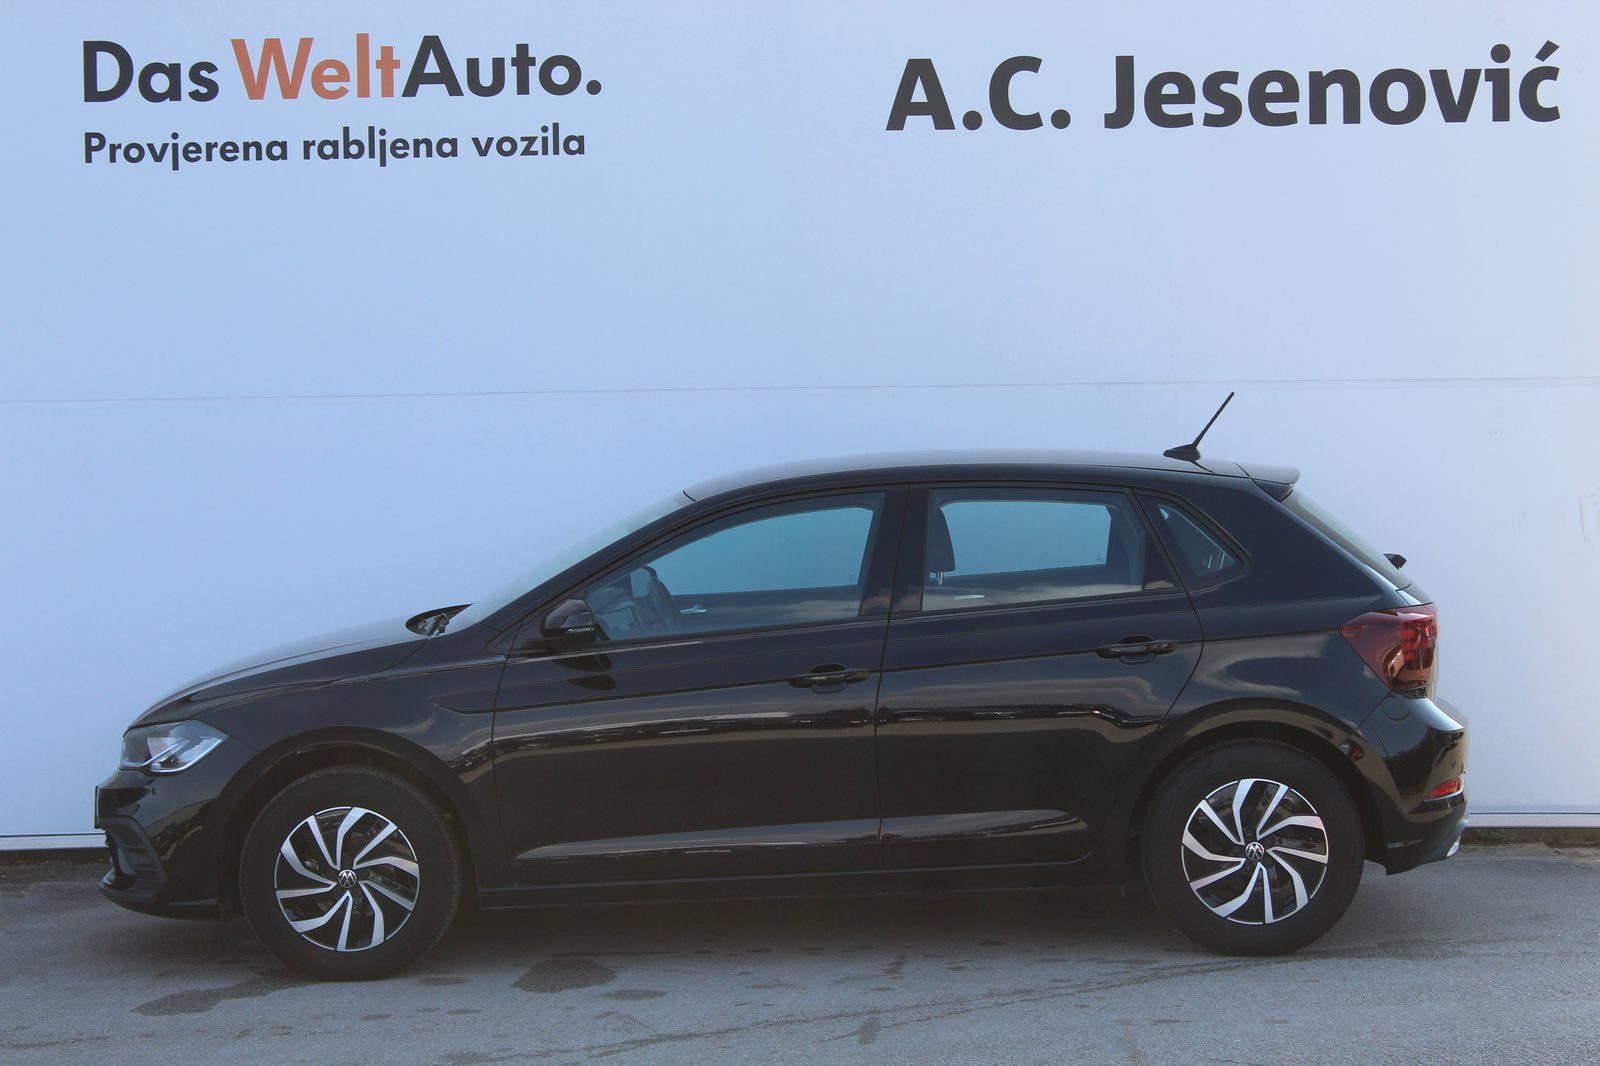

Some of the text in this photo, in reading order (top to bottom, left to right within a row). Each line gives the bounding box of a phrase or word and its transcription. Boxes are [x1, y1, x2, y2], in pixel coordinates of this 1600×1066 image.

[83, 32, 602, 103] Das WeltAuto.
[886, 40, 1560, 131] A.C. Jesenović
[84, 122, 585, 171] Provjerena rabljena vozila
